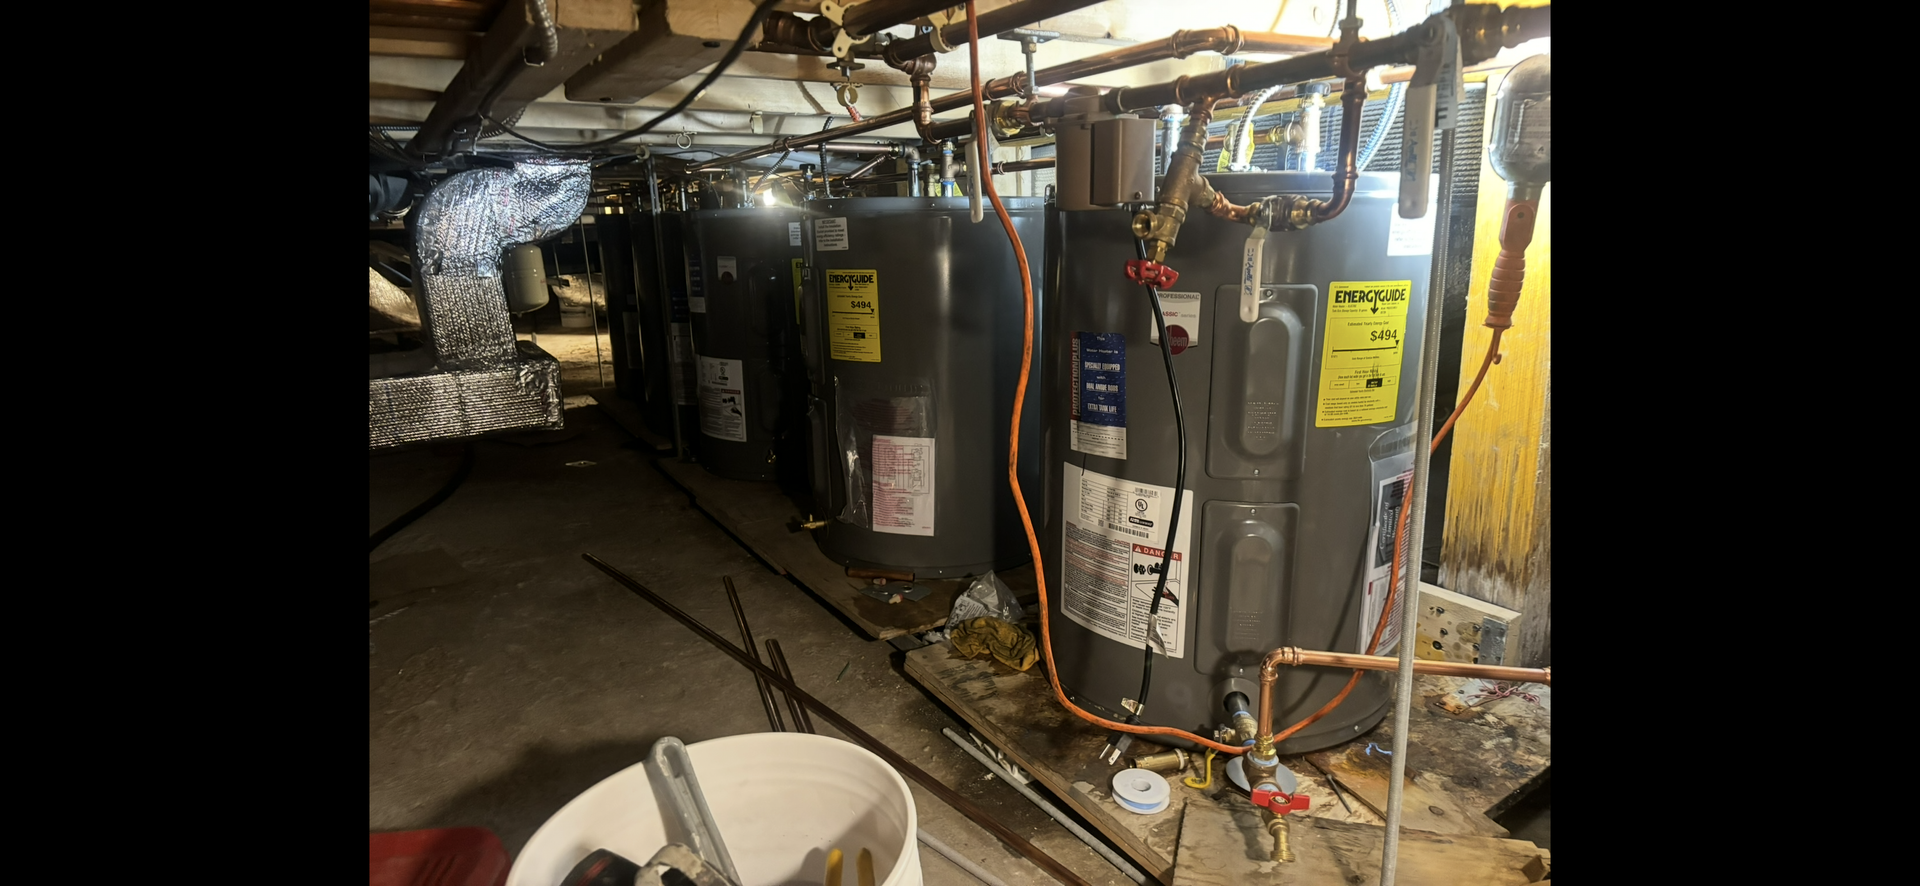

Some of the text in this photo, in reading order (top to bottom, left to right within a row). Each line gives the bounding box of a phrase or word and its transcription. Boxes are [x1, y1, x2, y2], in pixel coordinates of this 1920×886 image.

[829, 274, 874, 283] ENERGYGUIDE
[1335, 288, 1406, 304] ENERGYGUIDE
[851, 300, 872, 308] $494
[1370, 329, 1397, 342] $494
[1144, 547, 1179, 559] DANGR
